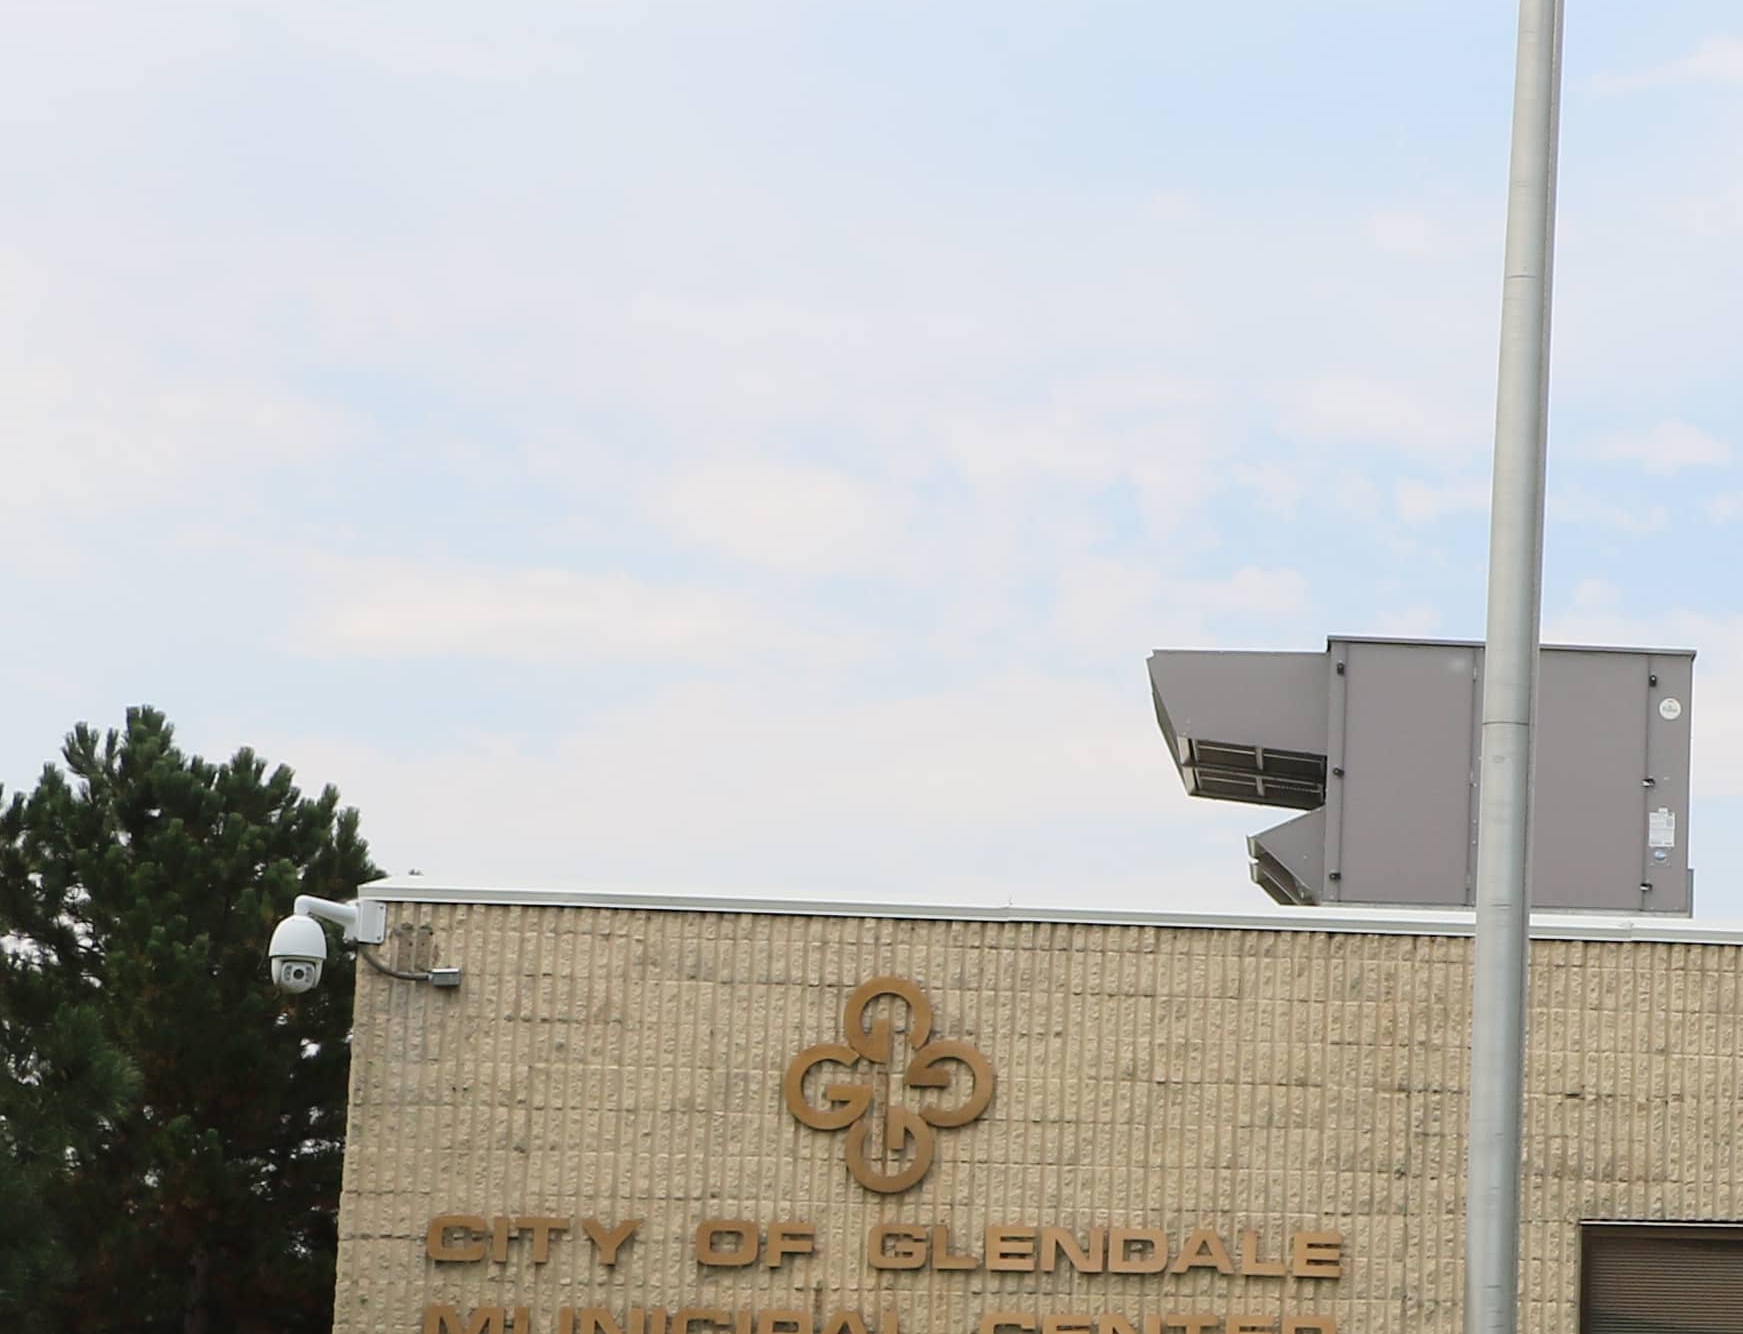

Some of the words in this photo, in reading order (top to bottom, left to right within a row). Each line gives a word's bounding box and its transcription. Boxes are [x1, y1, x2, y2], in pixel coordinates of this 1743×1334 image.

[426, 1214, 641, 1266] CITY
[696, 1219, 816, 1267] OF
[867, 1224, 1342, 1279] GLENDALE
